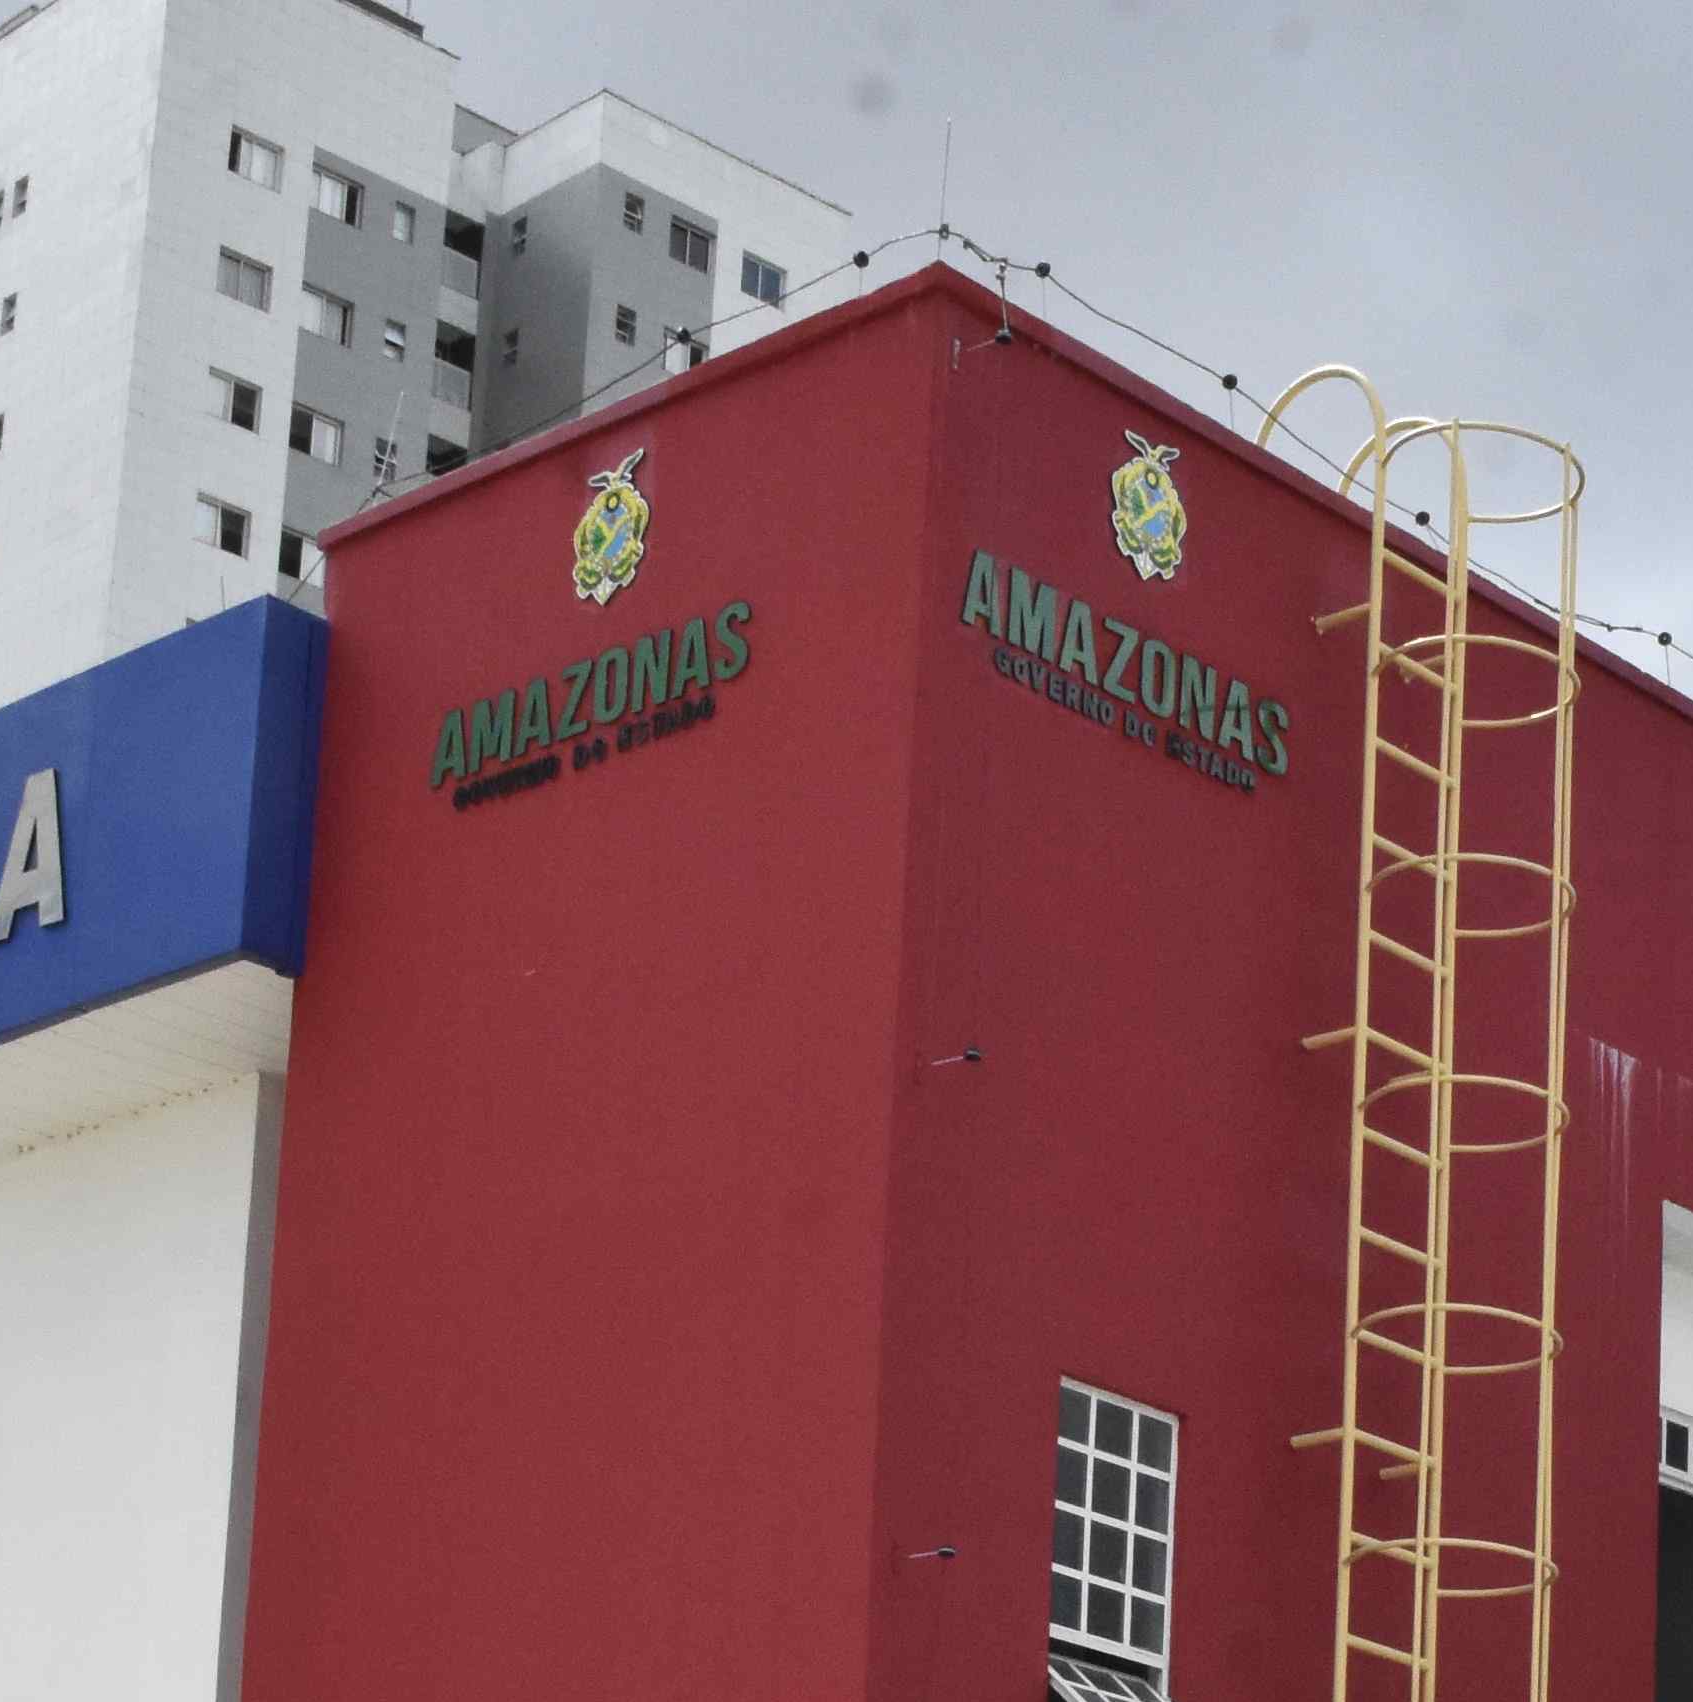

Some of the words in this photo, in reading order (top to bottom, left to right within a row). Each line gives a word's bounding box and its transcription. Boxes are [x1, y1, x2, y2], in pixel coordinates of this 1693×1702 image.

[430, 601, 752, 789] AMAZONAS
[962, 549, 1290, 775] AMAZONAS
[993, 646, 1117, 726] GOVERNO
[1123, 710, 1156, 746] DO
[1165, 730, 1255, 791] ESTADO
